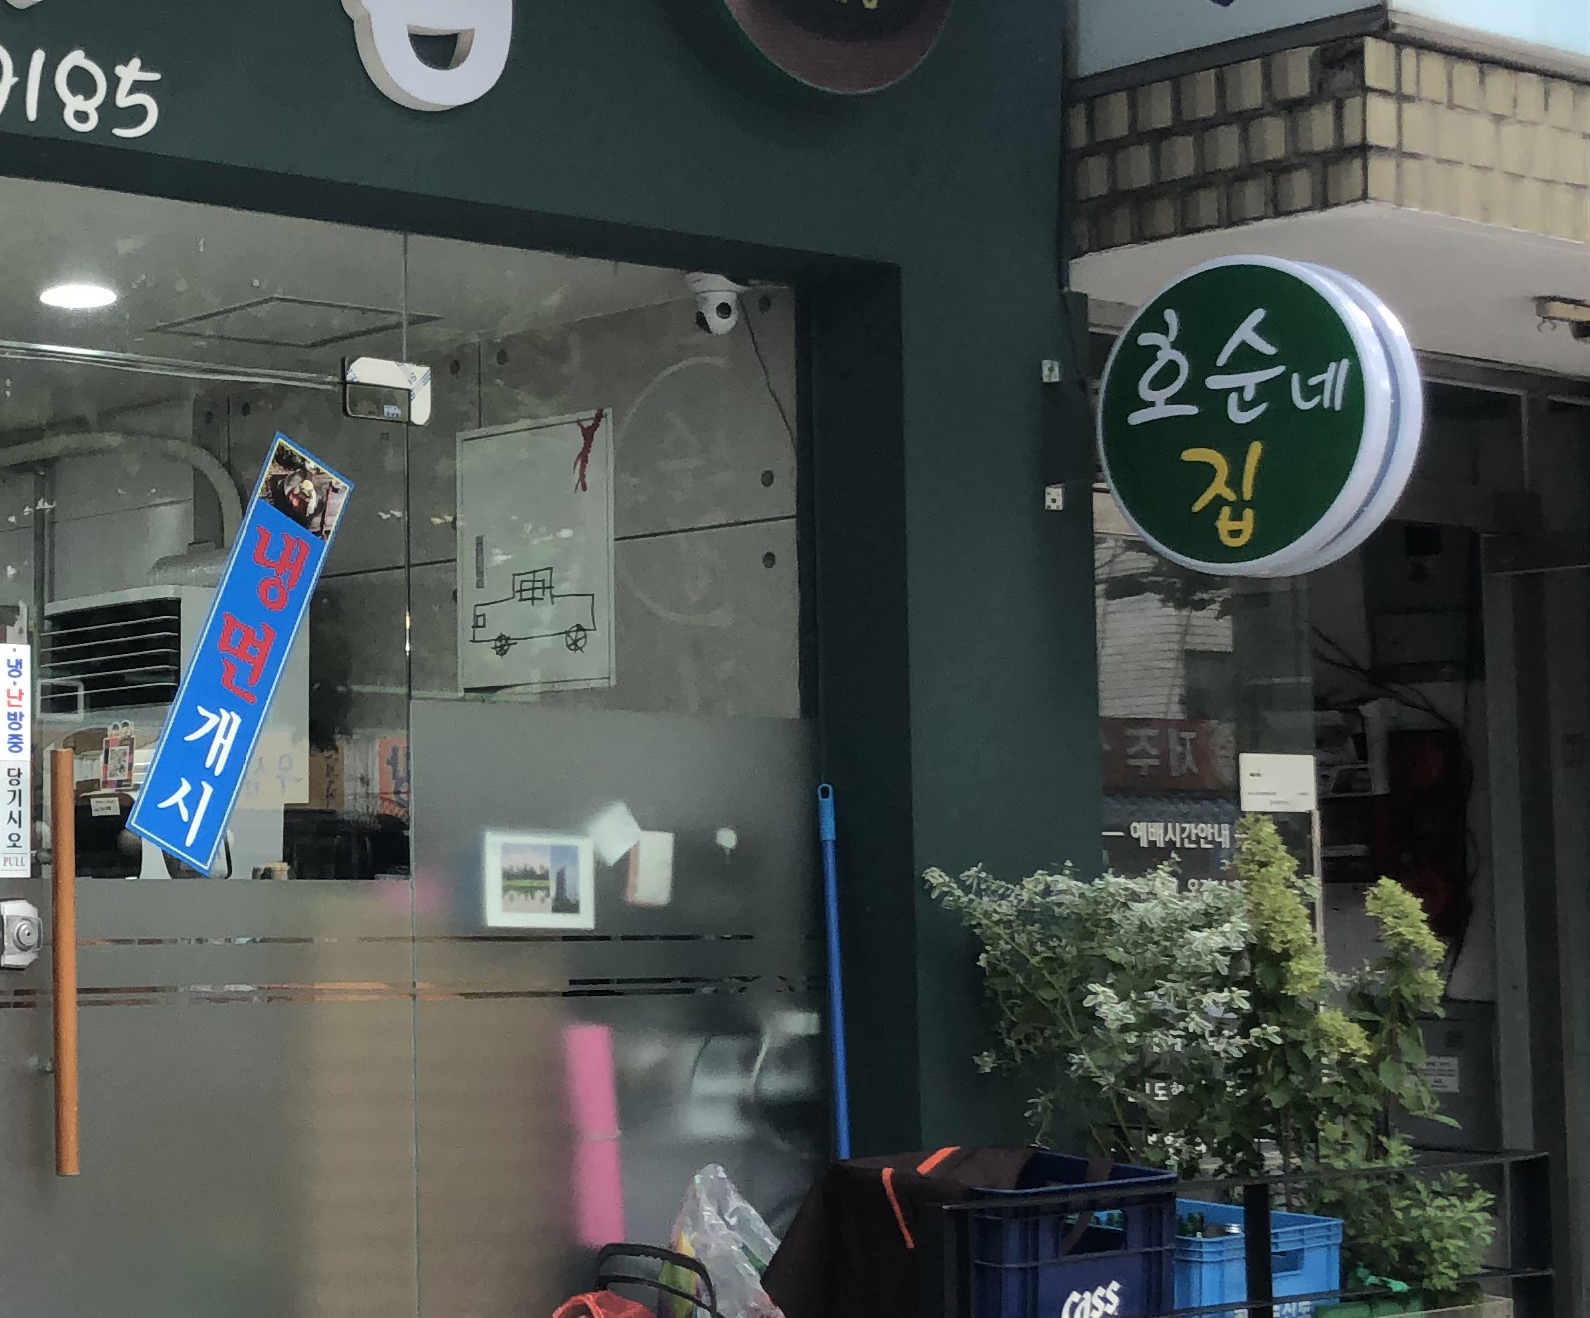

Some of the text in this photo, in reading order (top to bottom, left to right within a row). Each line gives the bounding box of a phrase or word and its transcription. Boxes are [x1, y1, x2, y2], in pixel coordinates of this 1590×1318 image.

[1127, 308, 1350, 425] 호순네
[1180, 441, 1262, 548] 집
[216, 524, 310, 706] 냉면
[6, 767, 24, 849] 당기시오
[156, 703, 242, 848] 개시
[1130, 821, 1231, 849] 예배시간안내
